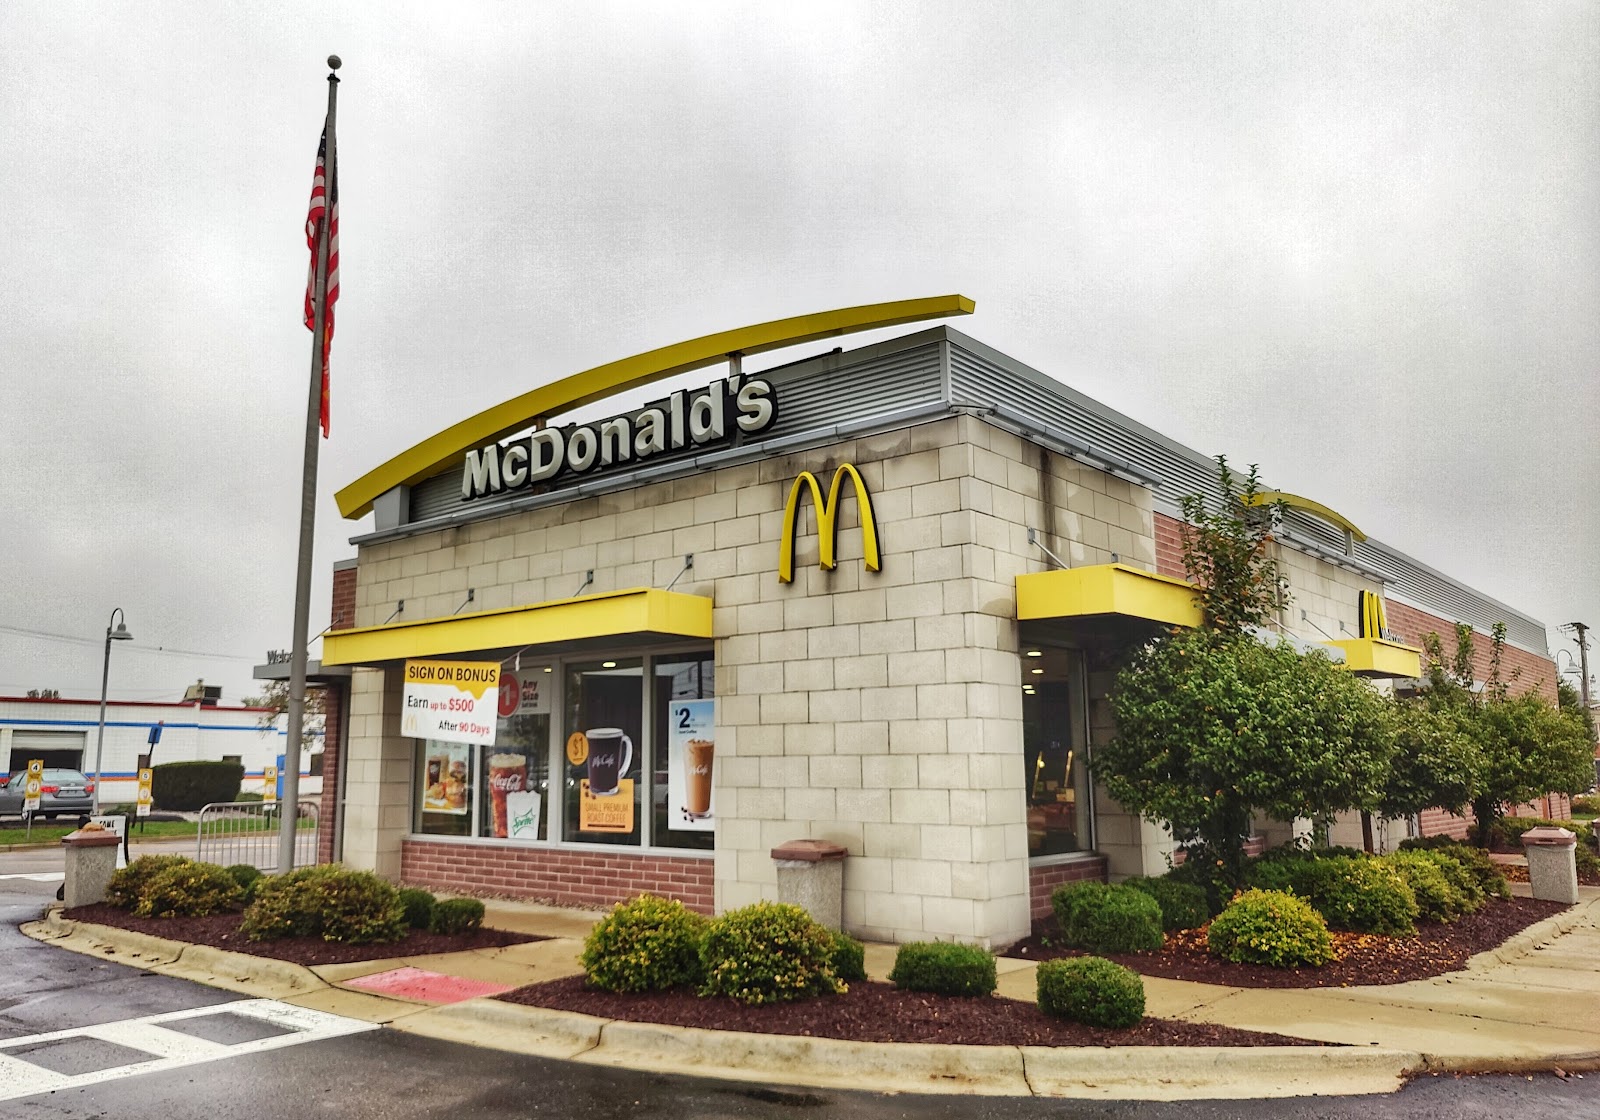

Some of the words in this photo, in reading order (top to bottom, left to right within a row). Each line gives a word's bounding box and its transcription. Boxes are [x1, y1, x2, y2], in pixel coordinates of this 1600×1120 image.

[461, 374, 775, 499] McDonald's
[409, 666, 435, 679] SIGN
[437, 667, 453, 680] ON
[456, 668, 496, 682] BONUS
[407, 696, 429, 708] Earn
[430, 703, 439, 711] up
[440, 702, 448, 711] to
[449, 697, 474, 713] $500
[438, 720, 458, 731] After
[459, 723, 469, 733] 90
[470, 723, 490, 737] Days
[572, 736, 584, 757] $1
[585, 802, 602, 812] SMALL
[603, 802, 629, 813] PREMIUM
[587, 812, 604, 822] ROAST
[605, 812, 627, 823] COFFEE
